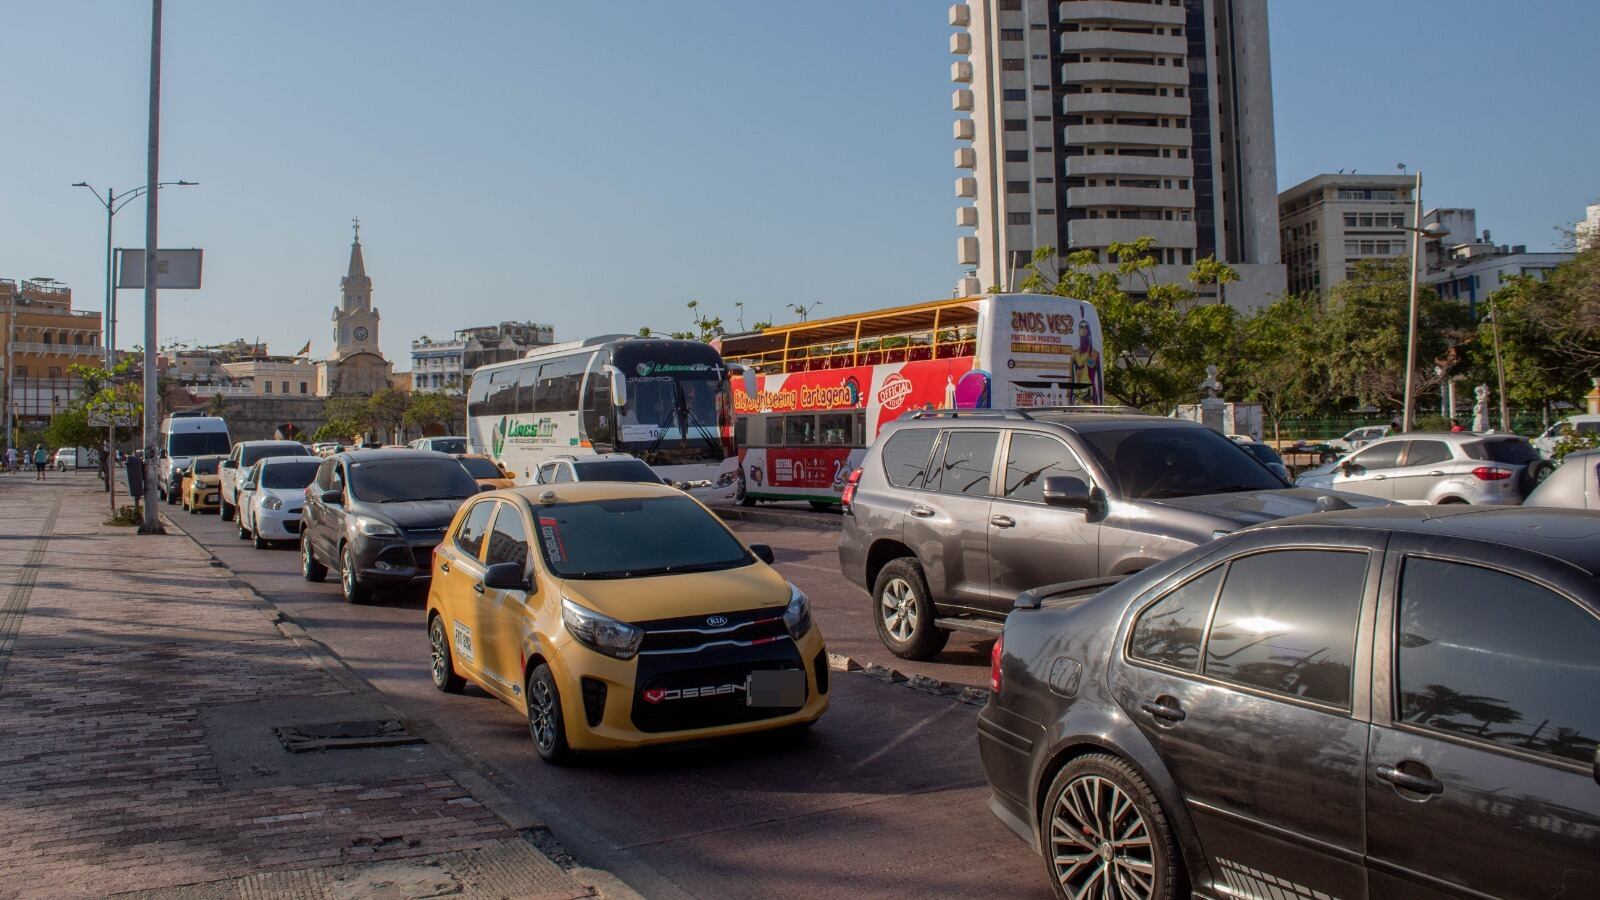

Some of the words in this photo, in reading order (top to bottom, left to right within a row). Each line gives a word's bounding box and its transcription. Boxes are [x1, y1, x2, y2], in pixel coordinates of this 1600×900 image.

[1011, 311, 1046, 333] ¿NOS
[1046, 313, 1075, 335] VES?
[800, 384, 852, 408] Cartagena
[880, 382, 909, 401] OFFICIAL
[648, 429, 658, 437] 10
[709, 616, 725, 624] KIA
[647, 684, 747, 701] VOSSEN
